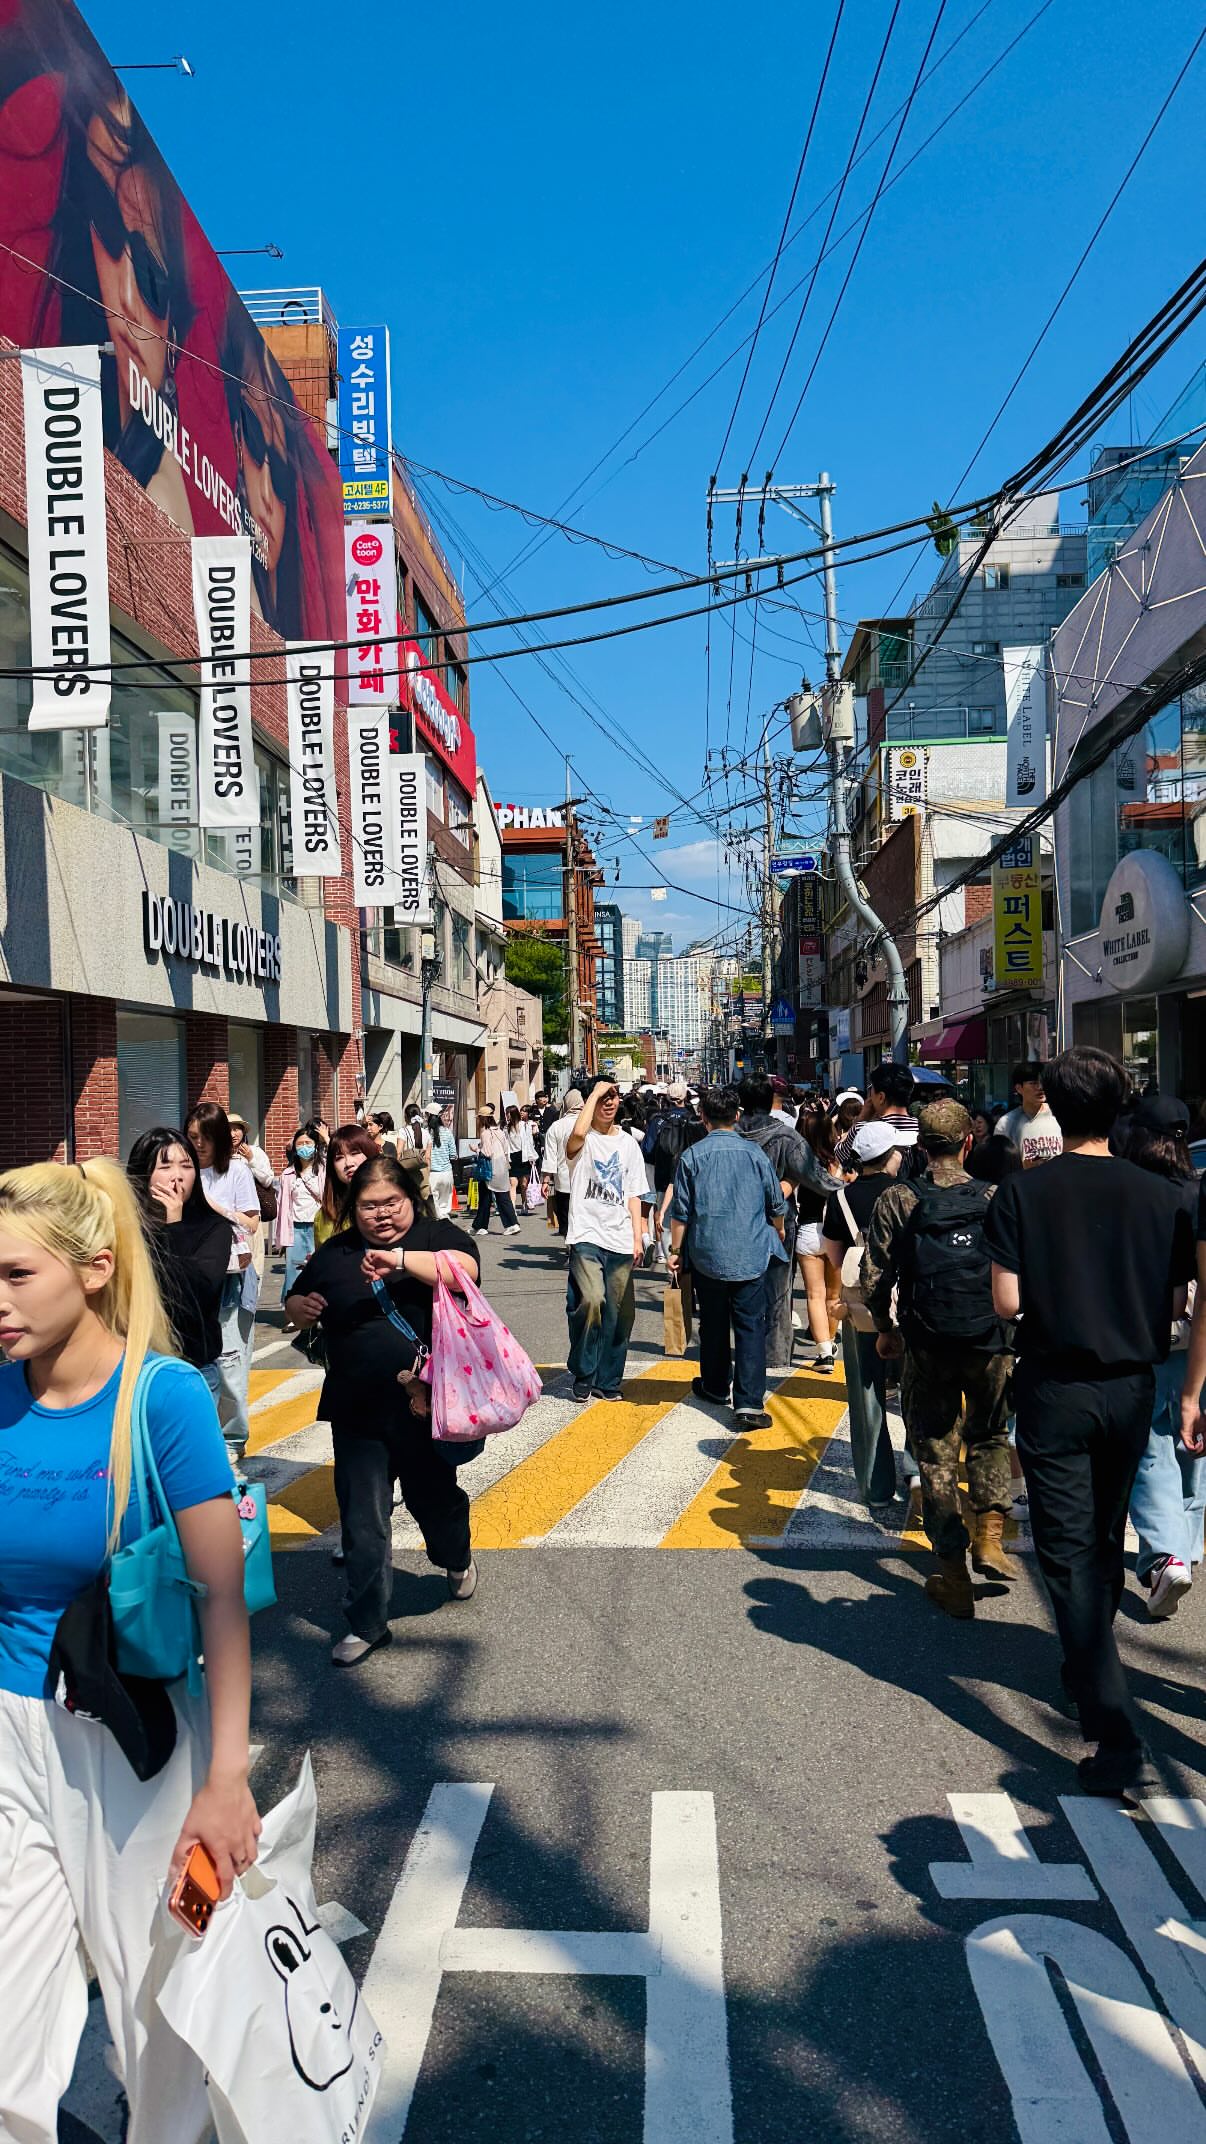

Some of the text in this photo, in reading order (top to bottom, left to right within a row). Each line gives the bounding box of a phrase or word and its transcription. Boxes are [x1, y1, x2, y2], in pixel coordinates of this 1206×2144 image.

[128, 357, 242, 537] DOUBLE LOVERS
[349, 334, 377, 474] 성수리빙텔
[44, 387, 83, 538] DOUBLE
[344, 482, 386, 498] 고시텔 4F
[356, 548, 377, 557] toon
[49, 549, 91, 698] LOVERS
[207, 566, 237, 677] DOUBLE
[355, 578, 385, 694] 만화카페
[212, 685, 244, 798] LOVERS
[299, 665, 328, 854] DOUBLE LOVERS
[896, 769, 921, 781] 코인
[1022, 706, 1033, 748] LABEL
[358, 728, 385, 888] DOUBLE LOVERS
[399, 772, 420, 911] DOUBLE LOVERS
[1002, 853, 1031, 867] 법인
[145, 892, 282, 982] DOUBLE LOVERS
[1003, 894, 1034, 973] 퍼스트
[1103, 928, 1151, 958] WHITE LABEL
